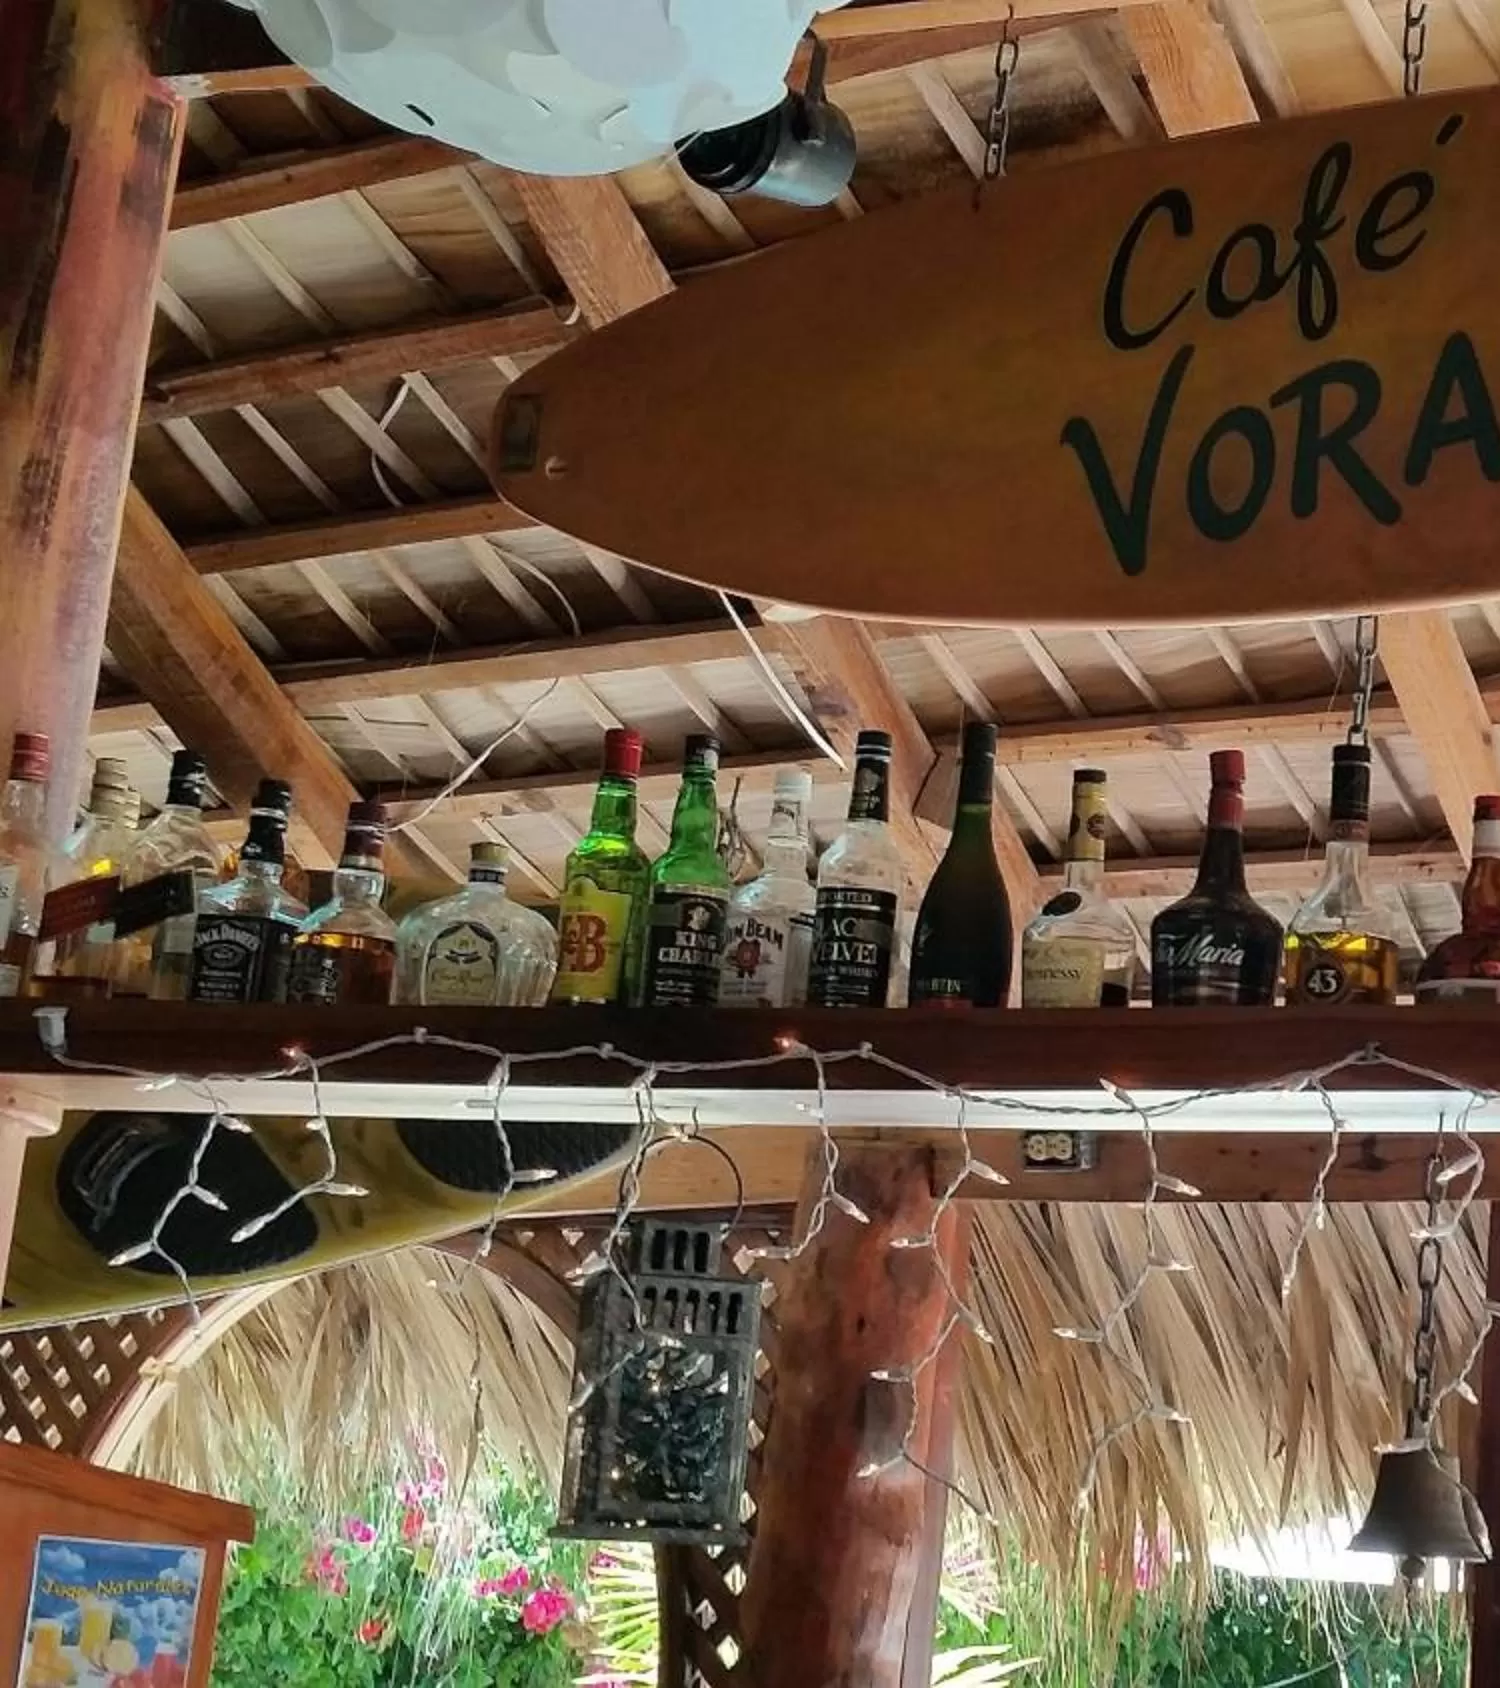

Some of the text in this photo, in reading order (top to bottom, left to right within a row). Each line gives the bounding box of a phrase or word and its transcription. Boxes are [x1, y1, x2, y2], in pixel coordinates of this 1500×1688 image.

[1102, 114, 1464, 350] Café
[745, 916, 784, 951] BEAM
[1177, 932, 1246, 968] Maria
[1307, 968, 1338, 993] 43
